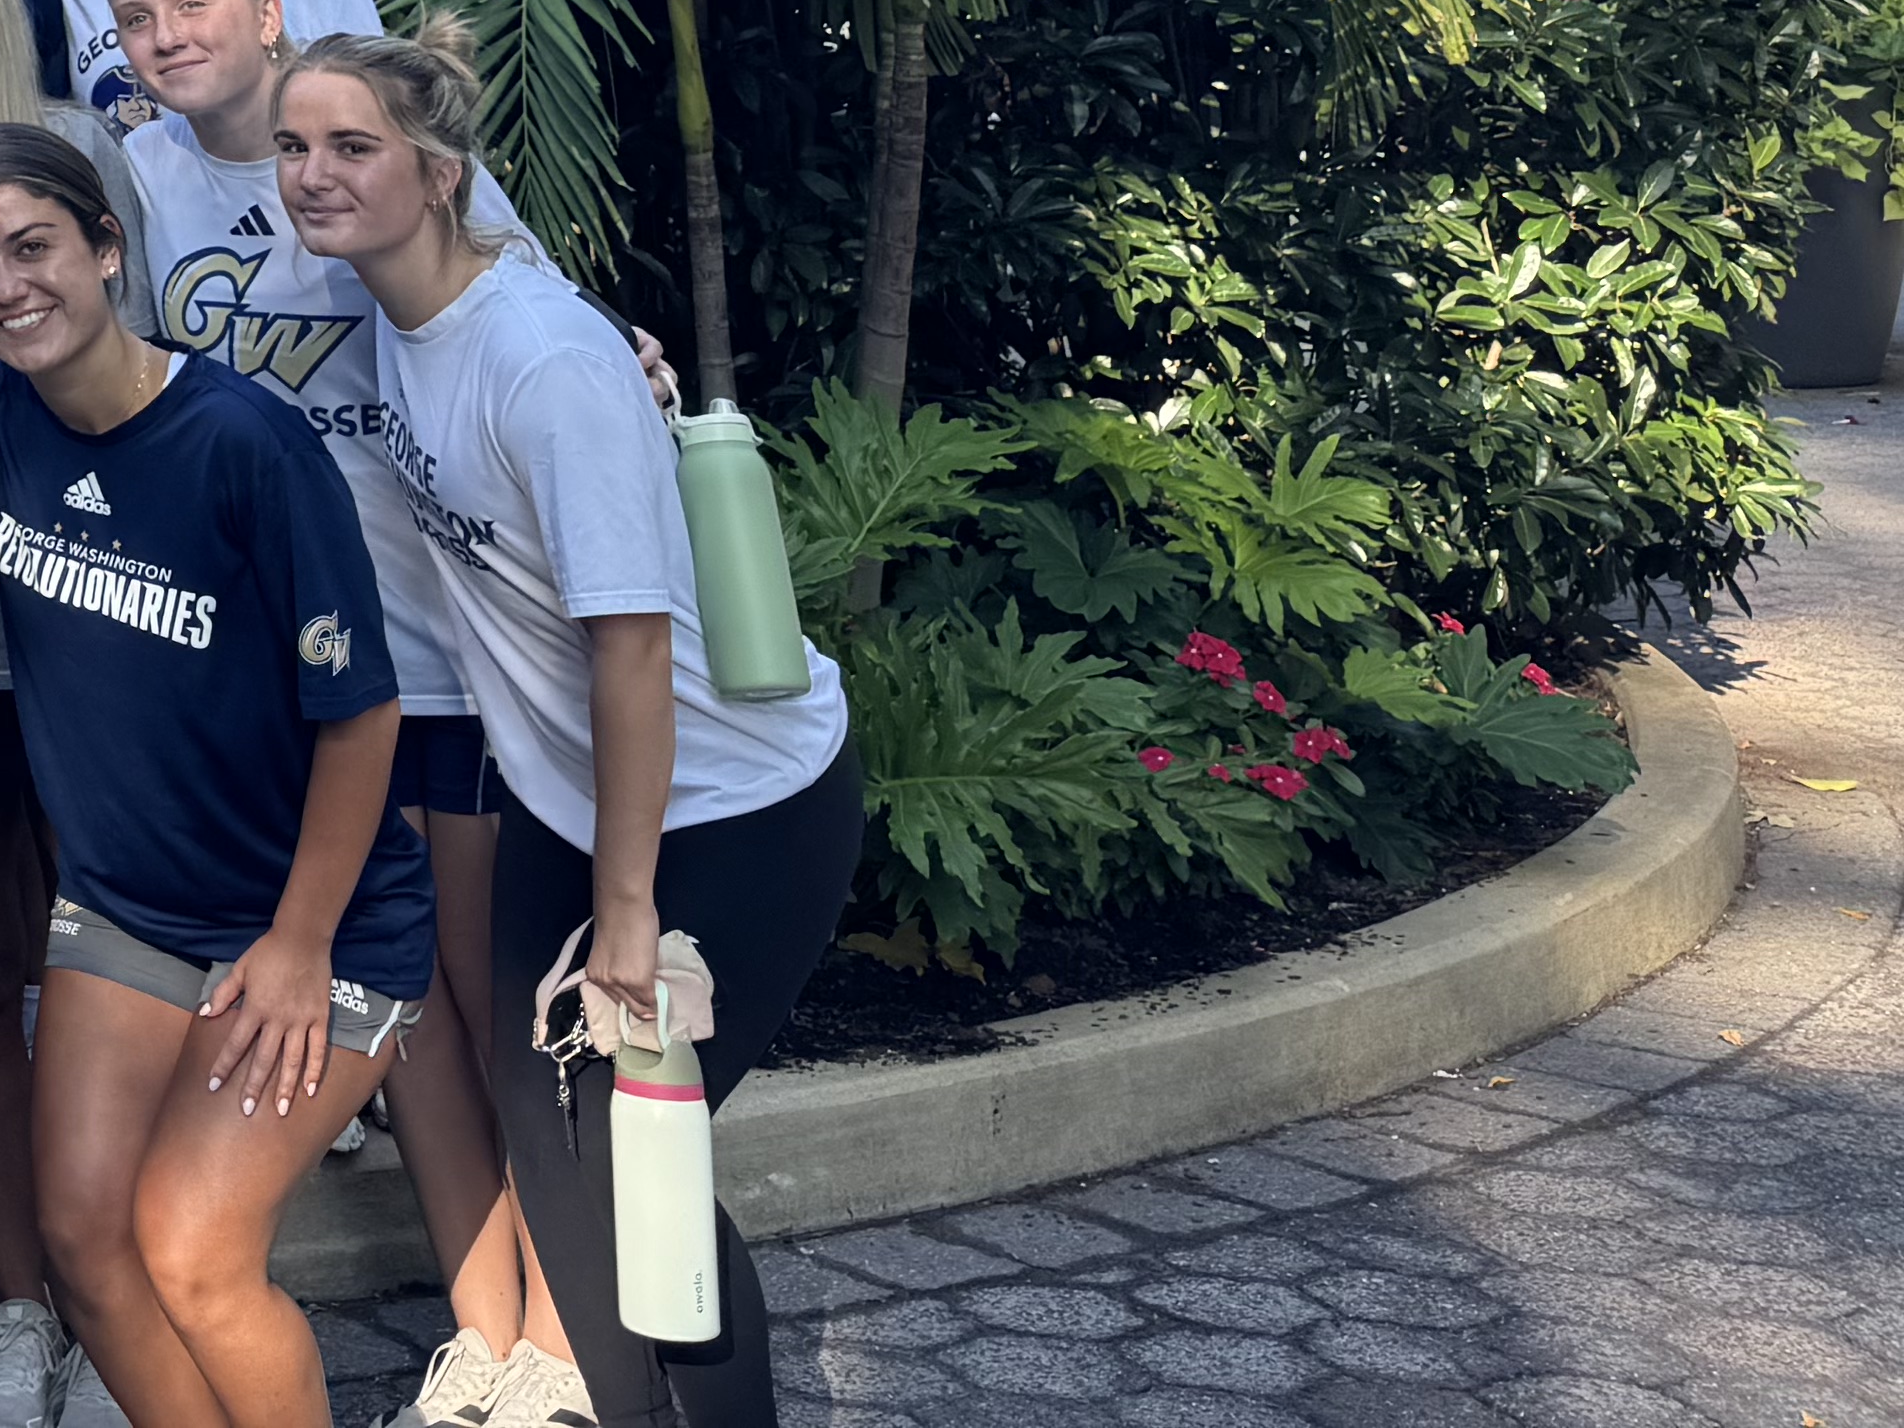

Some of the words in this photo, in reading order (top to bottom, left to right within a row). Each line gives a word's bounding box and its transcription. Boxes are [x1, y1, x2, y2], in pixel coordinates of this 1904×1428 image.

[162, 246, 365, 394] GW
[62, 492, 112, 516] adidas
[69, 541, 173, 583] WASHINGTON
